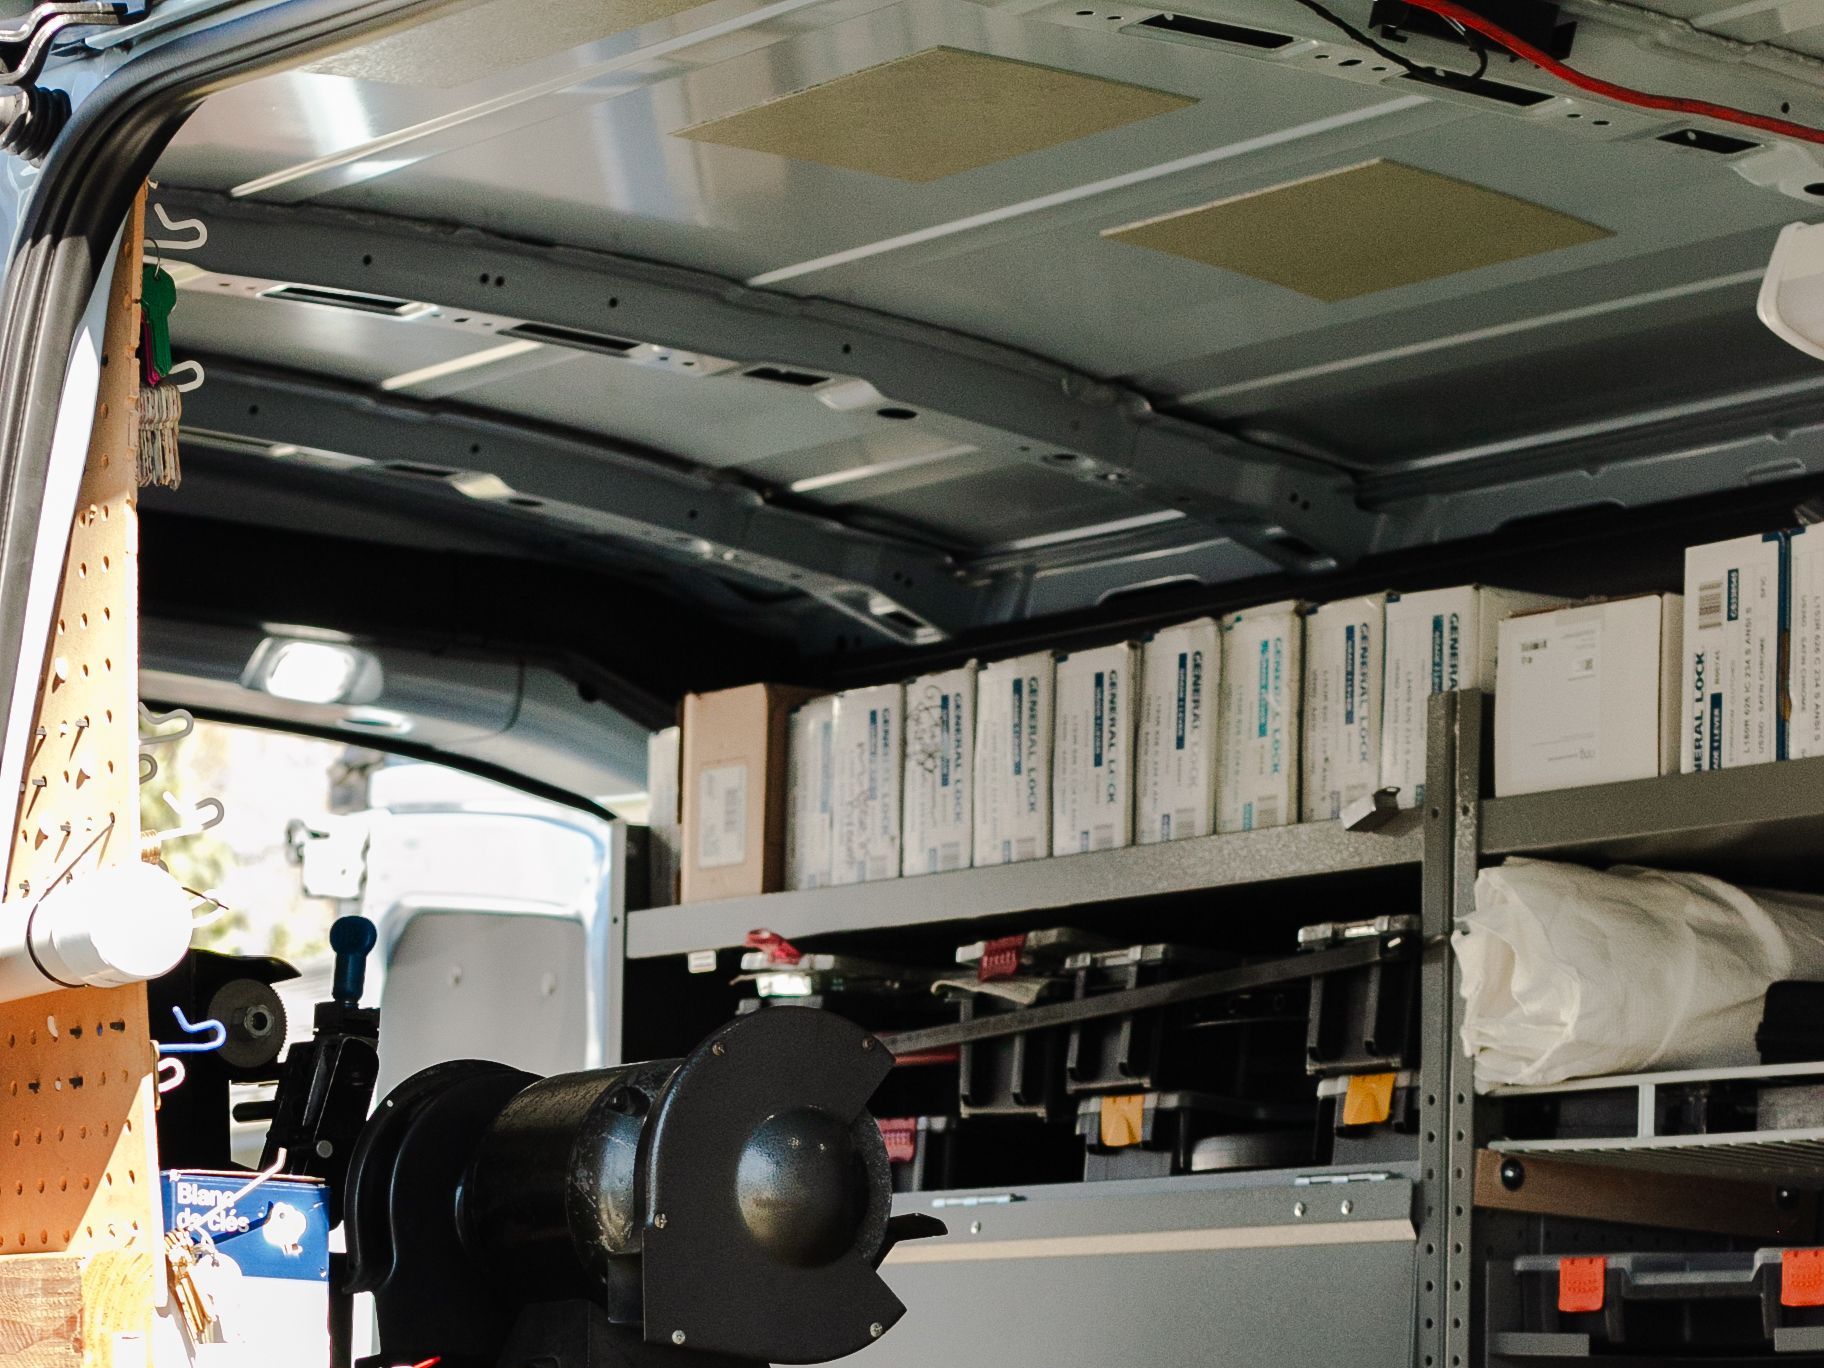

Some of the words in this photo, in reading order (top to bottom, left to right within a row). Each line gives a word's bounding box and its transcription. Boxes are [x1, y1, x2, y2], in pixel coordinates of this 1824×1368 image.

[1743, 618, 1752, 645] ANSI
[1800, 636, 1808, 666] SATIN
[1359, 622, 1370, 710] GENERAL
[1692, 652, 1705, 702] LOCK
[1743, 659, 1752, 678] 234
[1758, 637, 1766, 681] CHROME
[1107, 669, 1118, 753] GENERAL
[1191, 650, 1204, 731] GENERAL
[1757, 684, 1765, 713] SATIN
[1800, 667, 1808, 713] CHROME
[953, 692, 964, 769] GENERAL
[1028, 676, 1039, 761] GENERAL
[1359, 716, 1369, 763] LOCK
[1712, 708, 1720, 740] LEVER
[1270, 728, 1282, 777] LOCK
[953, 779, 963, 824] LOCK
[1028, 767, 1038, 814] LOCK
[176, 1207, 202, 1229] de
[207, 1208, 250, 1233] clés
